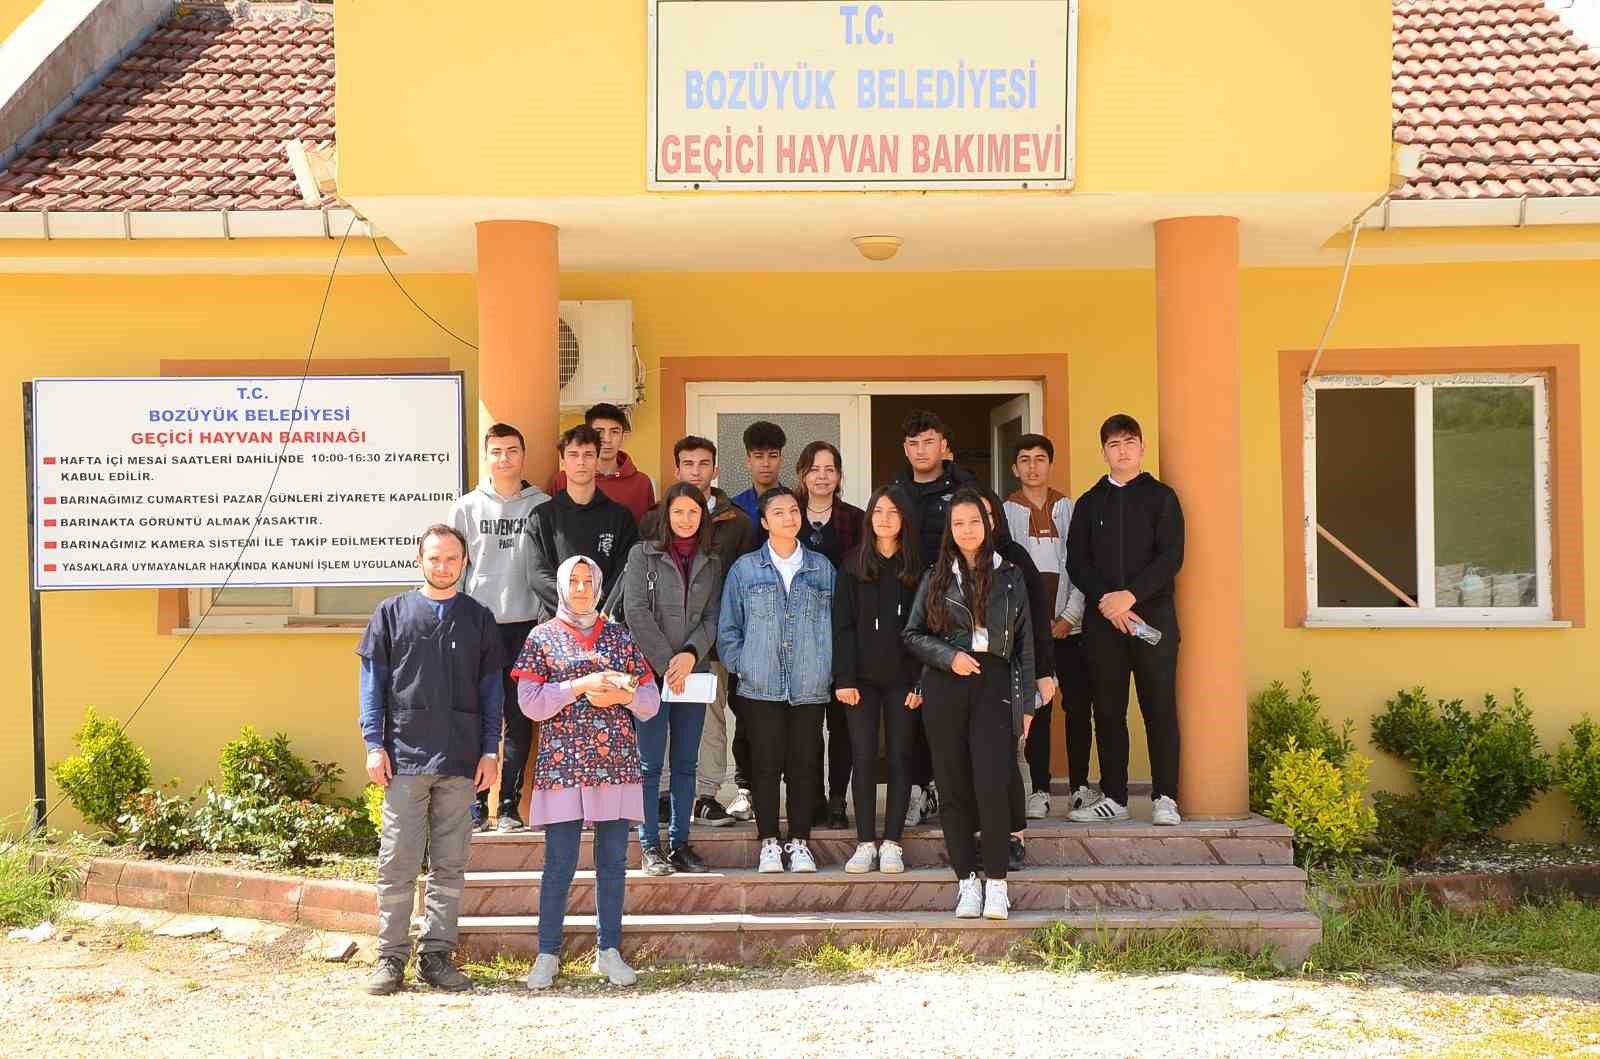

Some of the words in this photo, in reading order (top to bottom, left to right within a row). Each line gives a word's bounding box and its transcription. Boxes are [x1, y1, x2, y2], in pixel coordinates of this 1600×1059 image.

[839, 5, 894, 45] T.C.
[684, 62, 836, 110] BOZÜYÜK
[857, 60, 1038, 110] BELEDİYESİ
[661, 126, 765, 181] GEÇİCİ
[776, 134, 900, 174] HAYVAN
[912, 124, 1062, 174] BAKIMEVİ
[236, 387, 269, 400] T.C.
[149, 407, 239, 422] BOZÜYÜK
[245, 406, 350, 422] BELEDİYESİ
[131, 429, 193, 447] GEÇİCİ
[199, 431, 273, 444] HAYVAN
[279, 428, 367, 444] BARINAĞI
[60, 456, 102, 465] HAFTA
[106, 454, 123, 467] İÇİ
[127, 454, 167, 465] MESAİ
[171, 454, 232, 465] SAATLERİ
[236, 453, 305, 465] DAHİLİNDE
[311, 452, 381, 463] 10:00-16:30
[384, 451, 451, 465] ZİYARETÇİ
[61, 472, 104, 481] KABUL
[109, 471, 155, 481] EDİLİR.
[60, 493, 143, 505] BARINAĞIMIZ
[147, 492, 220, 504] CUMARTESİ
[223, 494, 263, 503] PAZAR
[269, 492, 323, 503] GÜNLERİ
[327, 491, 386, 502] ZİYARETE
[389, 492, 457, 502] KAPALIDIR.
[60, 517, 135, 527] BARINAKTA
[139, 515, 202, 527] GÖRÜNTÜ
[206, 517, 251, 526] ALMAK
[254, 515, 323, 526] YASAKTIR.
[480, 518, 528, 535] GIVENCH
[60, 538, 148, 550] BARINAĞIMIZ
[151, 539, 206, 549] KAMERA
[209, 538, 260, 548] SİSTEMİ
[264, 536, 284, 547] İLE
[291, 536, 328, 547] TAKİP
[63, 562, 129, 571] YASAKLARA
[132, 562, 207, 571] UYMAYANLAR
[209, 561, 268, 571] HAKKINDA
[271, 559, 315, 571] KANUNİ
[317, 559, 350, 572] İŞLEM
[353, 559, 421, 569] UYGULANAC
